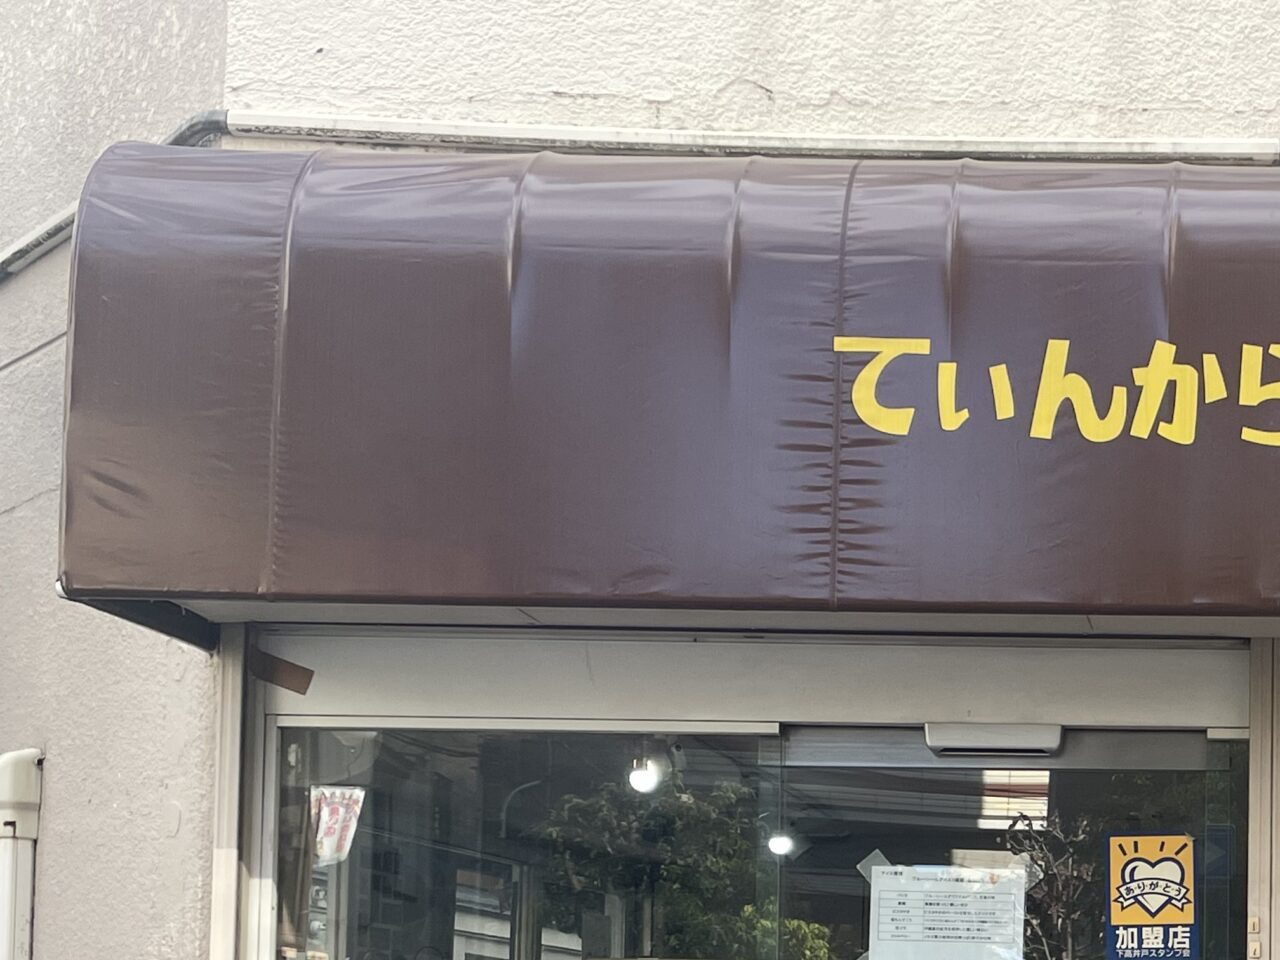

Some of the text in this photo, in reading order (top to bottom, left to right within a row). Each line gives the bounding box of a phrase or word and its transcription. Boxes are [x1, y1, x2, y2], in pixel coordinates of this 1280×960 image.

[1115, 926, 1191, 949] 加盟店
[1115, 948, 1192, 958] 下高井戸スタンプ会
